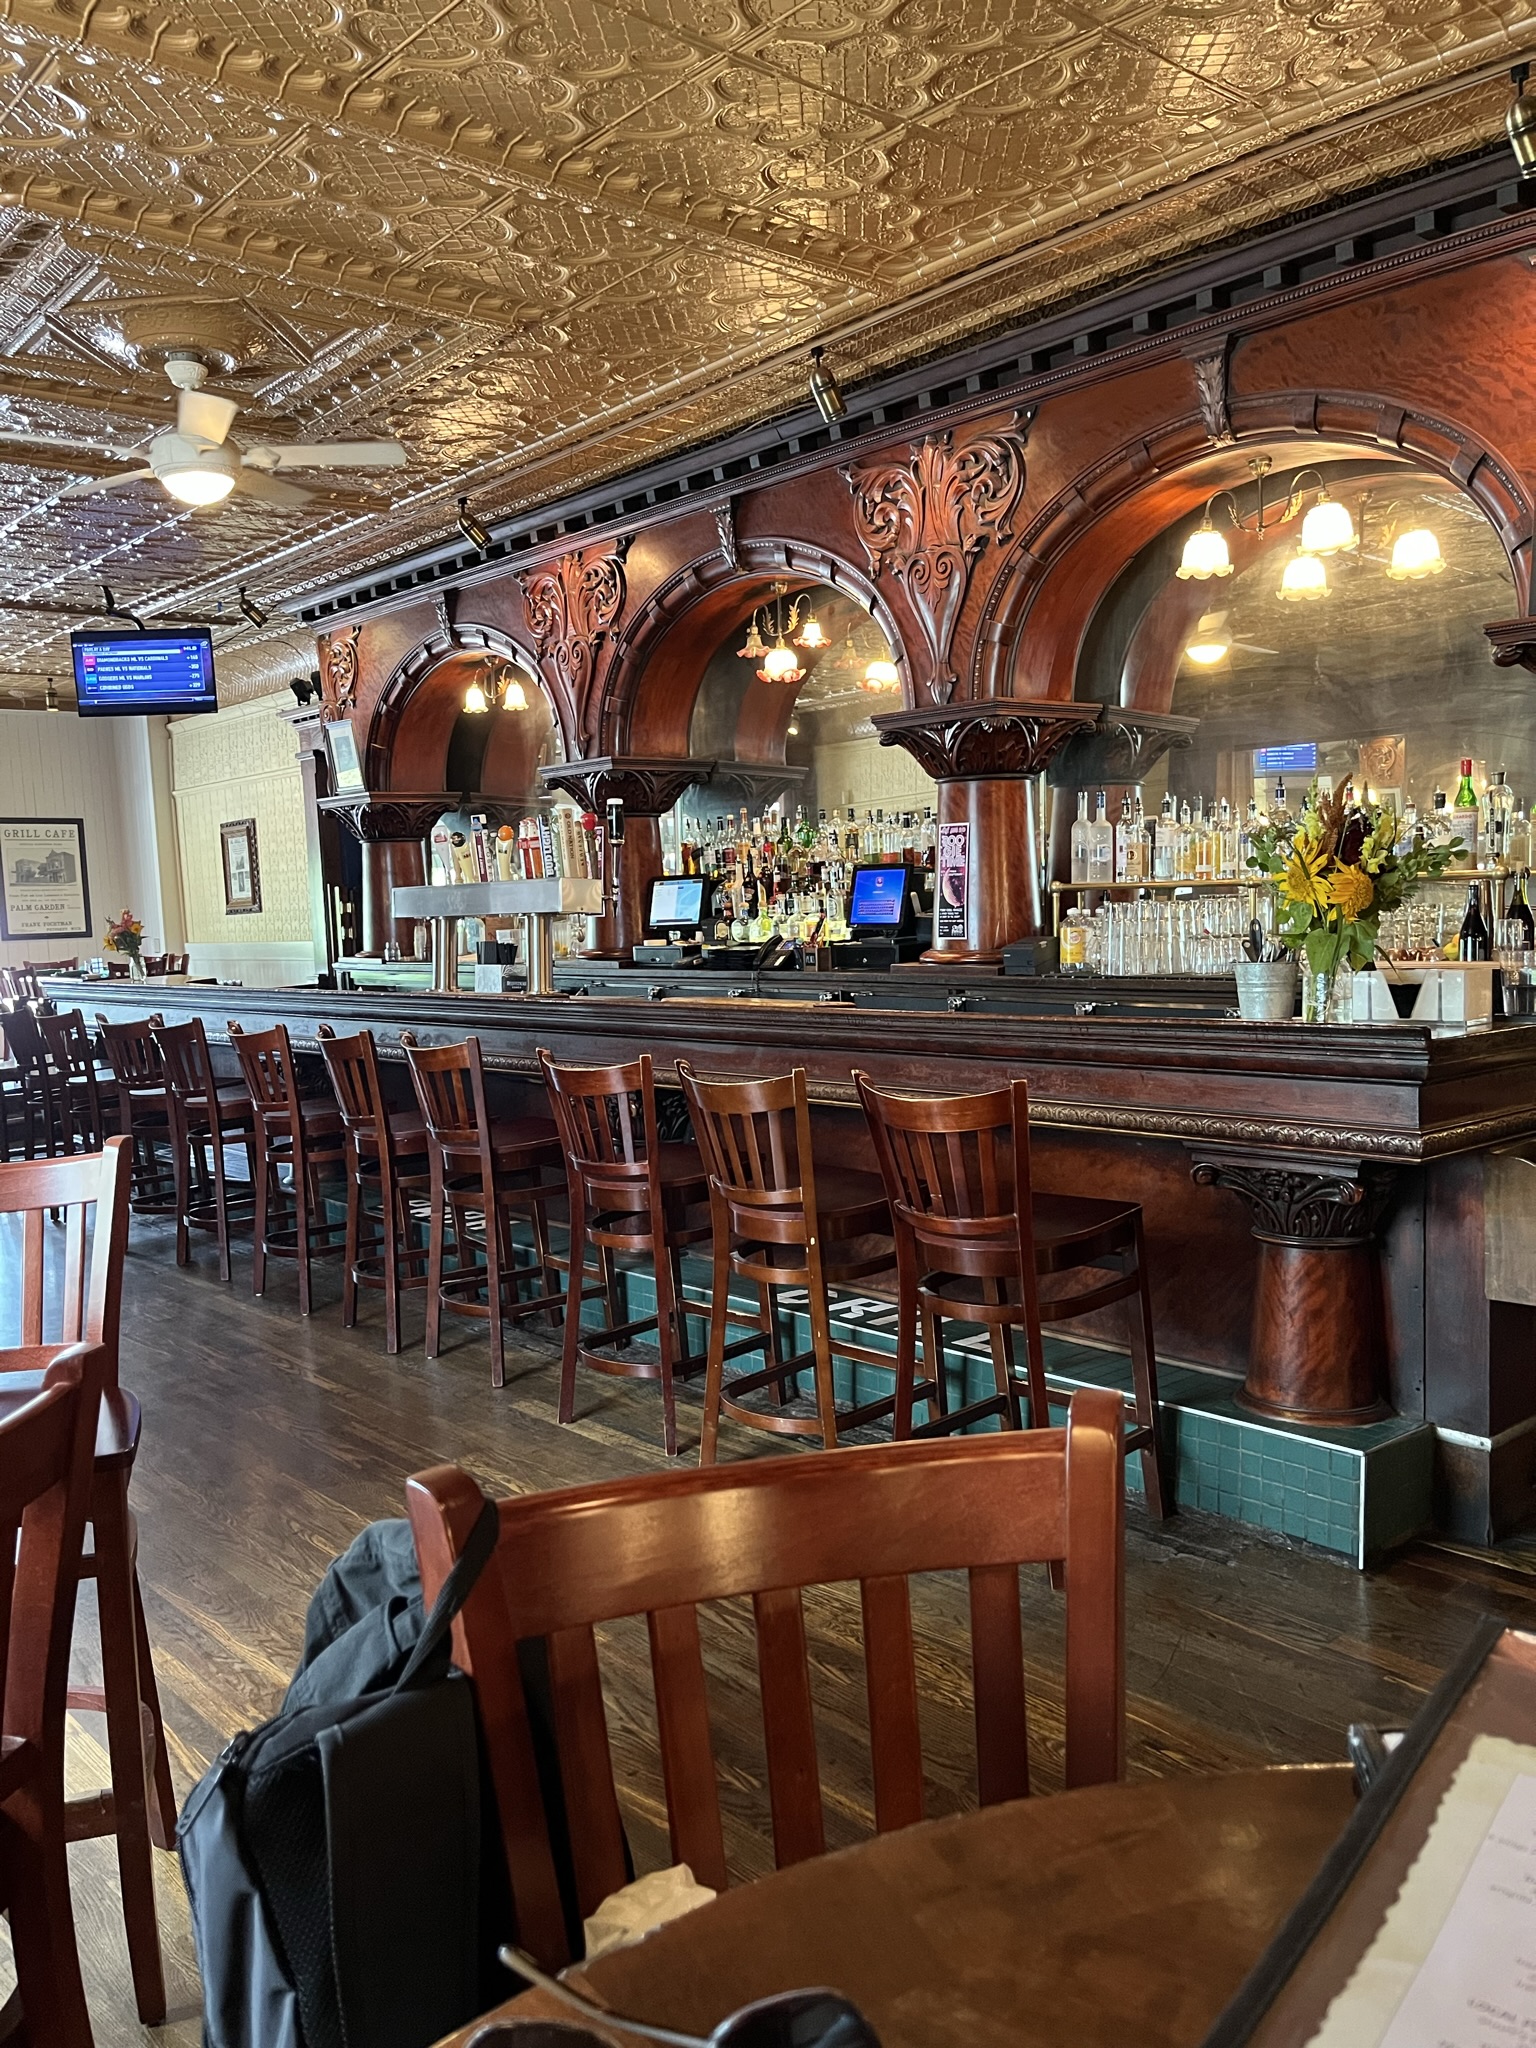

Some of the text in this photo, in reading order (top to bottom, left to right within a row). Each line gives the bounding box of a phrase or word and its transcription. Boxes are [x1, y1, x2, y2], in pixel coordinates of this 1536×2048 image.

[4, 829, 76, 838] GRILL CAFE
[542, 826, 555, 876] BUD LIGHT
[34, 903, 65, 911] GARDEN
